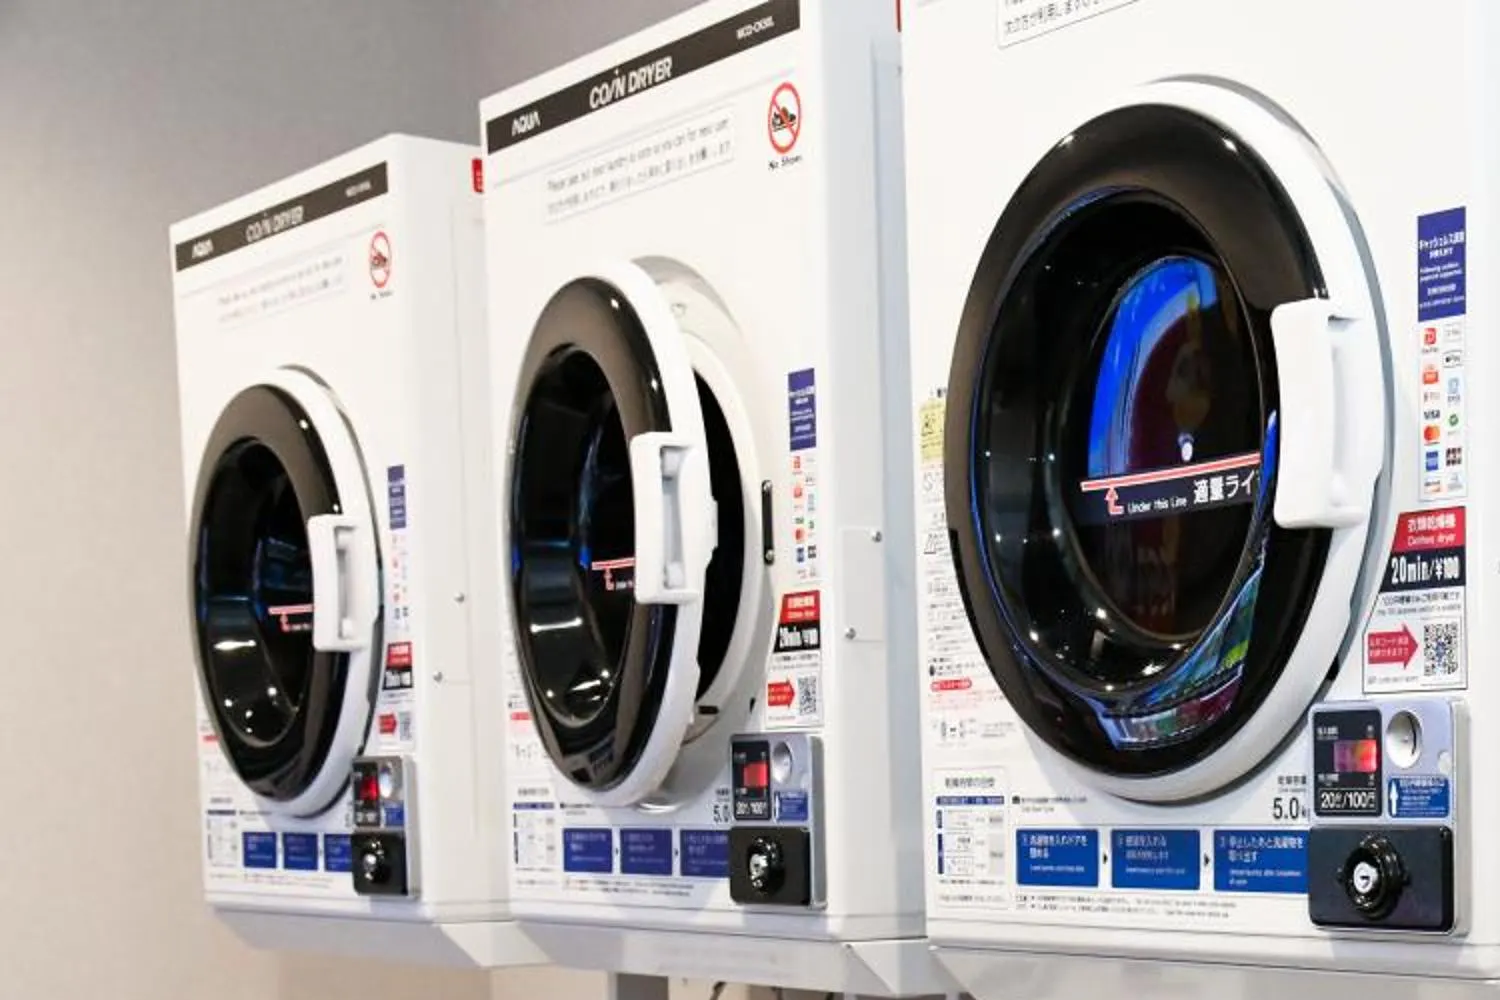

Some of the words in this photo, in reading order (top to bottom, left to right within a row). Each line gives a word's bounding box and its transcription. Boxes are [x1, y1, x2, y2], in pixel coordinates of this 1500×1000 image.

[627, 55, 674, 95] DRYER
[511, 110, 542, 138] AQUA
[1194, 470, 1261, 504] 適量ライ
[1127, 501, 1150, 513] Under
[1391, 555, 1460, 584] 20min/¥100
[1273, 797, 1300, 820] 5.0
